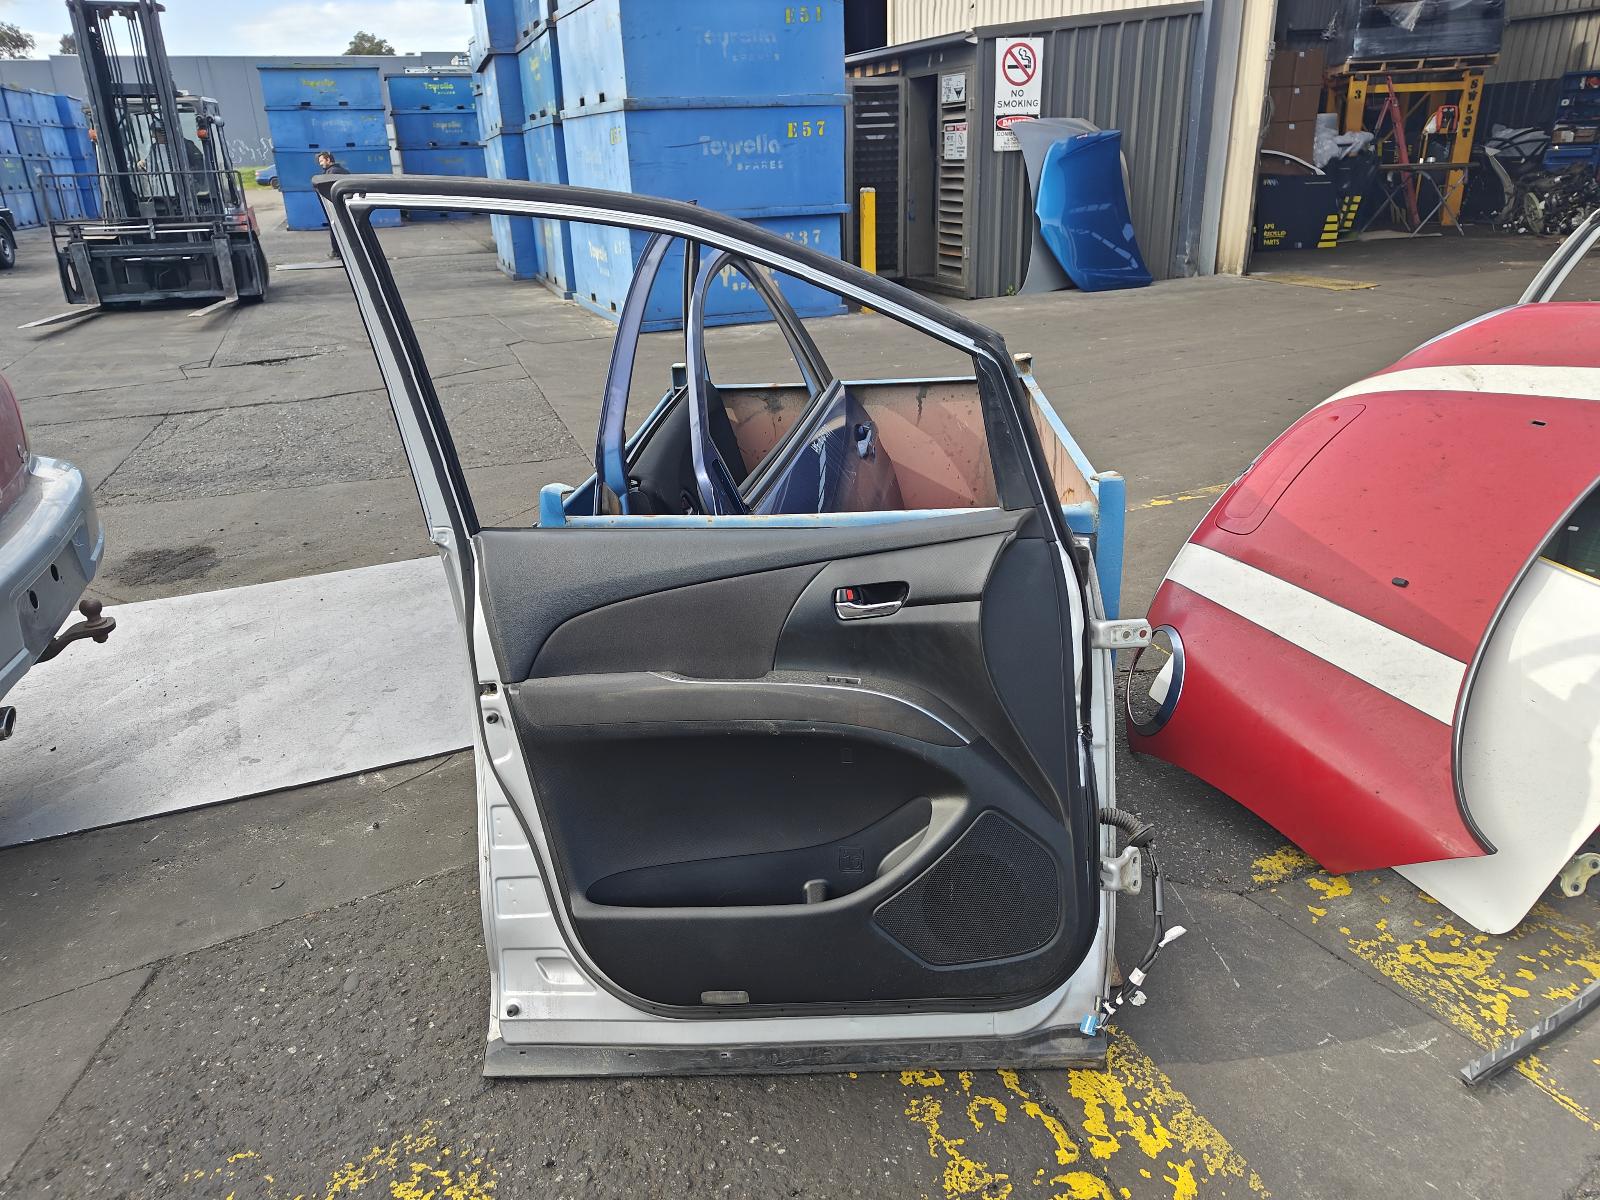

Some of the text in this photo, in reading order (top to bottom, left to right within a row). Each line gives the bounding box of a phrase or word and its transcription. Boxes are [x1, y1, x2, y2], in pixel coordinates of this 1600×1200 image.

[1010, 89, 1025, 98] NO
[1354, 89, 1362, 100] 3
[996, 99, 1039, 109] SMOKING
[787, 120, 826, 139] E57
